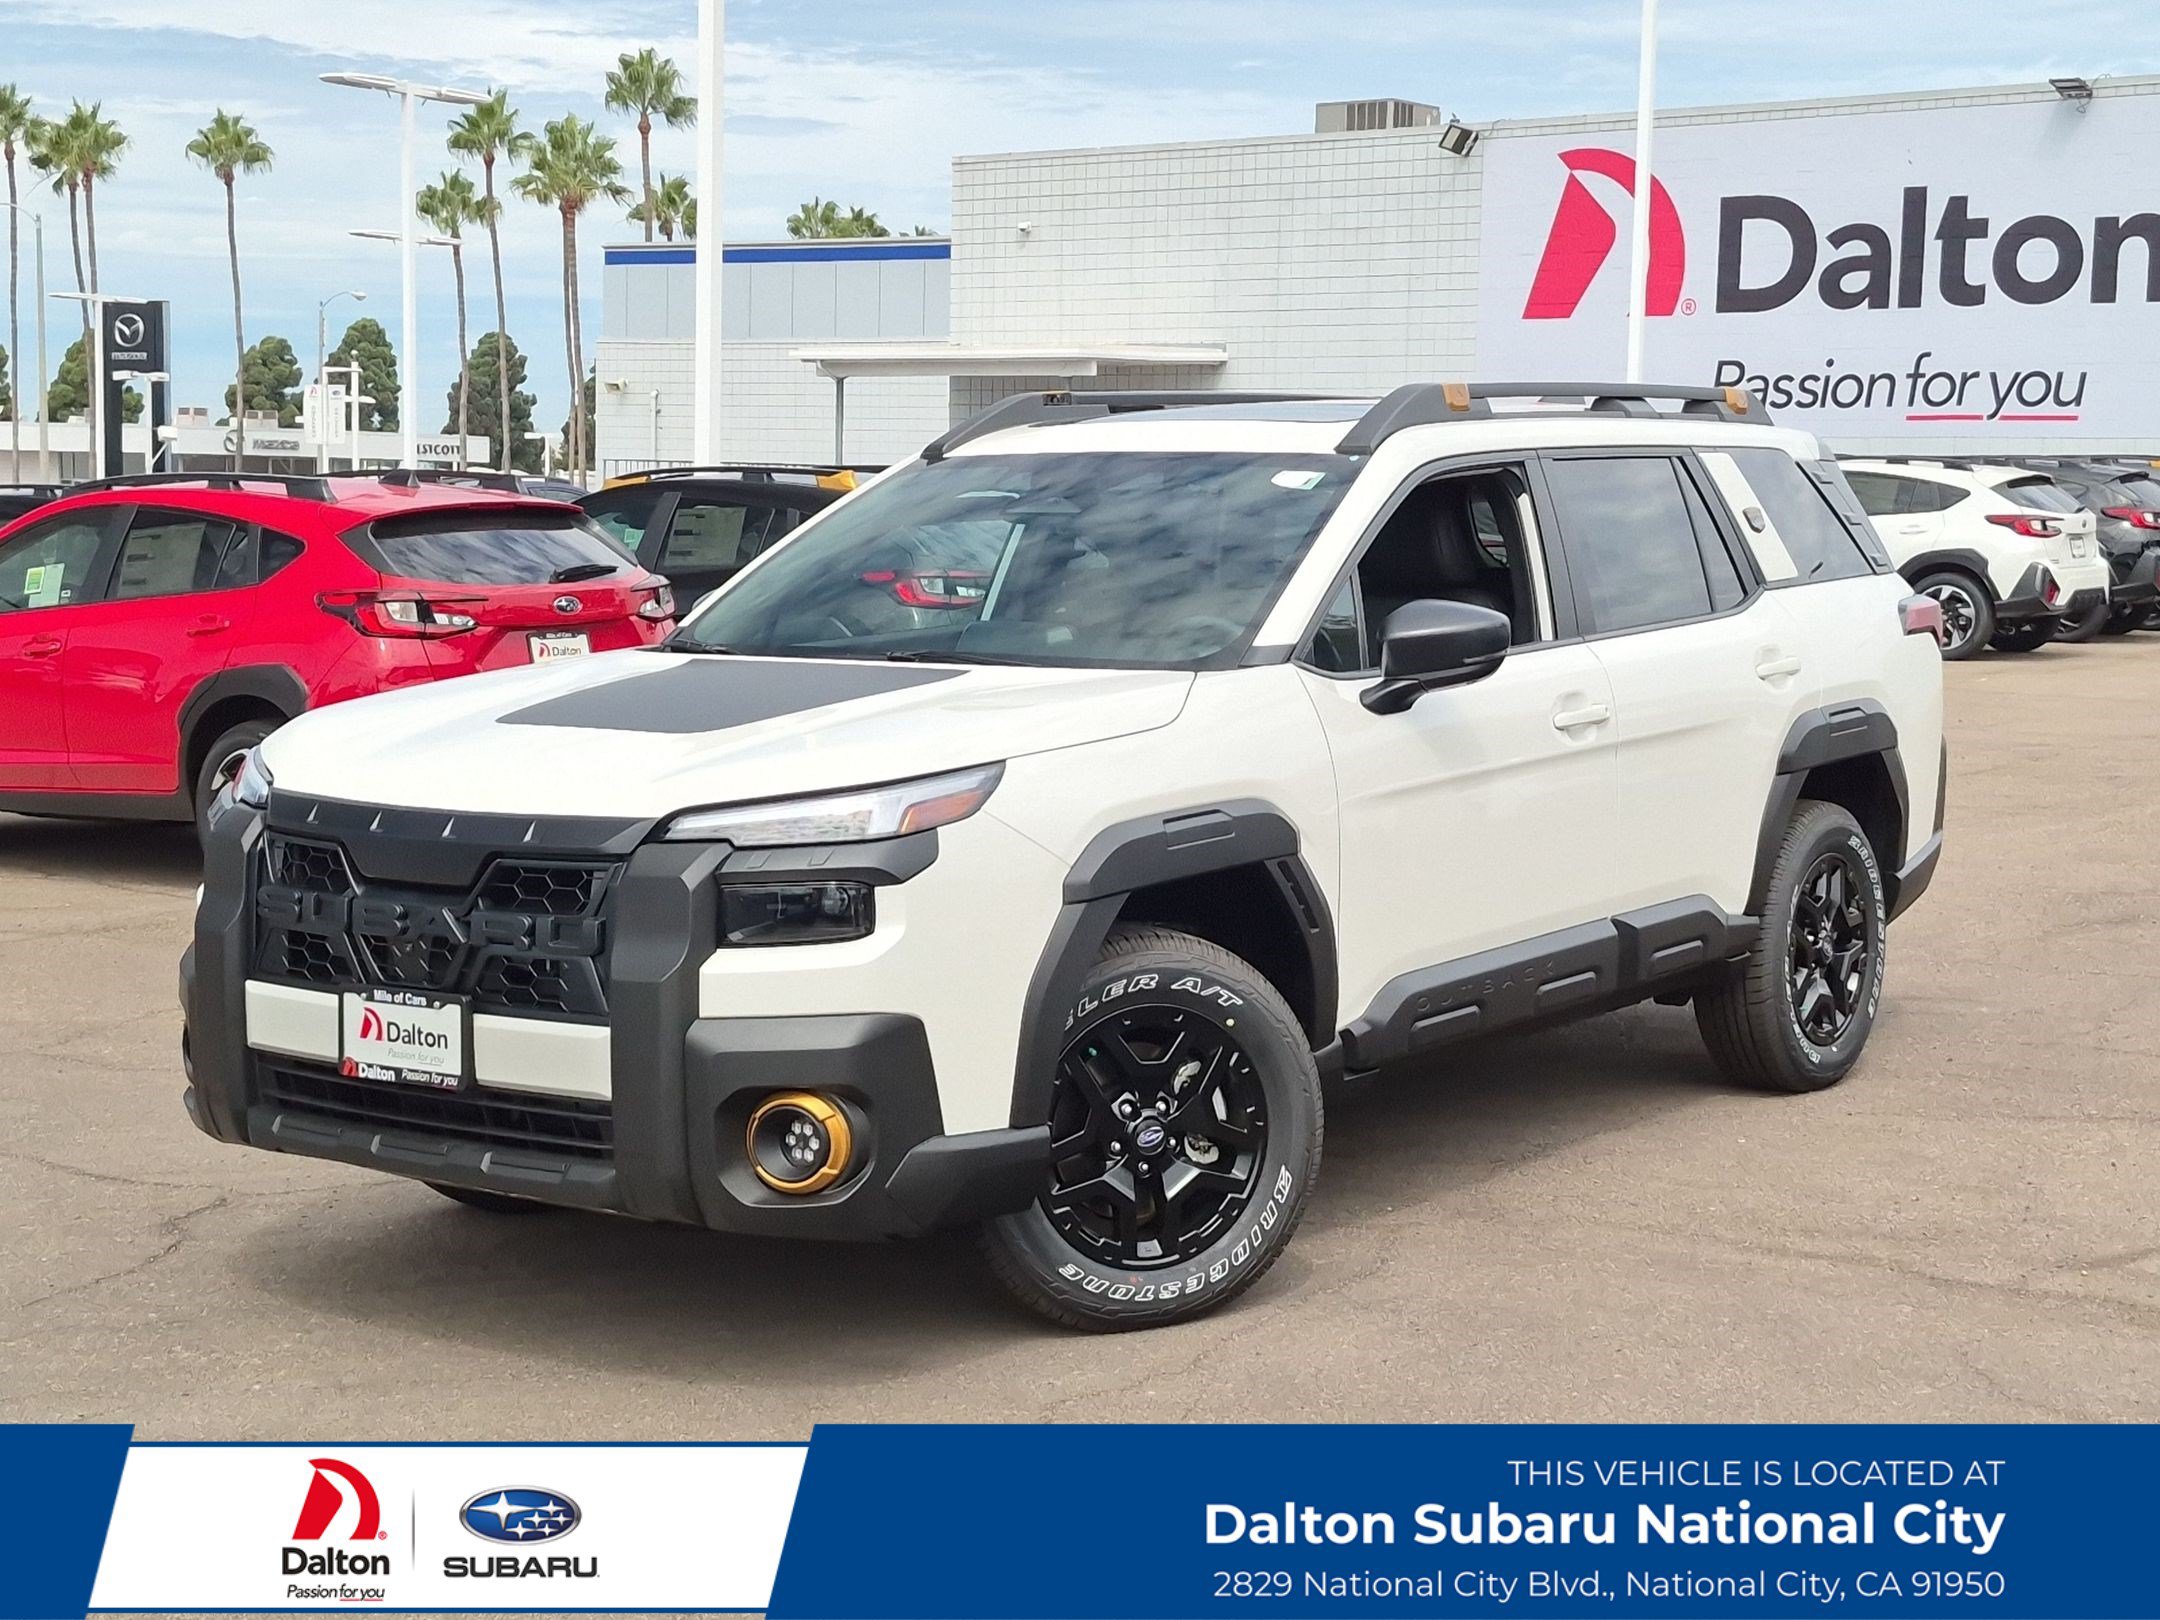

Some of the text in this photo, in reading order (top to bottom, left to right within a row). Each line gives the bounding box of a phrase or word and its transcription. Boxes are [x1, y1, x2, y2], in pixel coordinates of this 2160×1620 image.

[1716, 187, 2160, 313] Dalton
[1714, 351, 2088, 421] Passion for you
[257, 885, 607, 957] SUBARU
[373, 989, 427, 1006] Mile of Cars
[1170, 976, 1243, 1007] A/T
[1416, 960, 1556, 1013] OUTBACK
[386, 1020, 448, 1049] Dalton
[359, 1063, 396, 1081] Dalton
[401, 1068, 458, 1087] Passion for you
[1058, 1164, 1293, 1302] BRIDGESTONE
